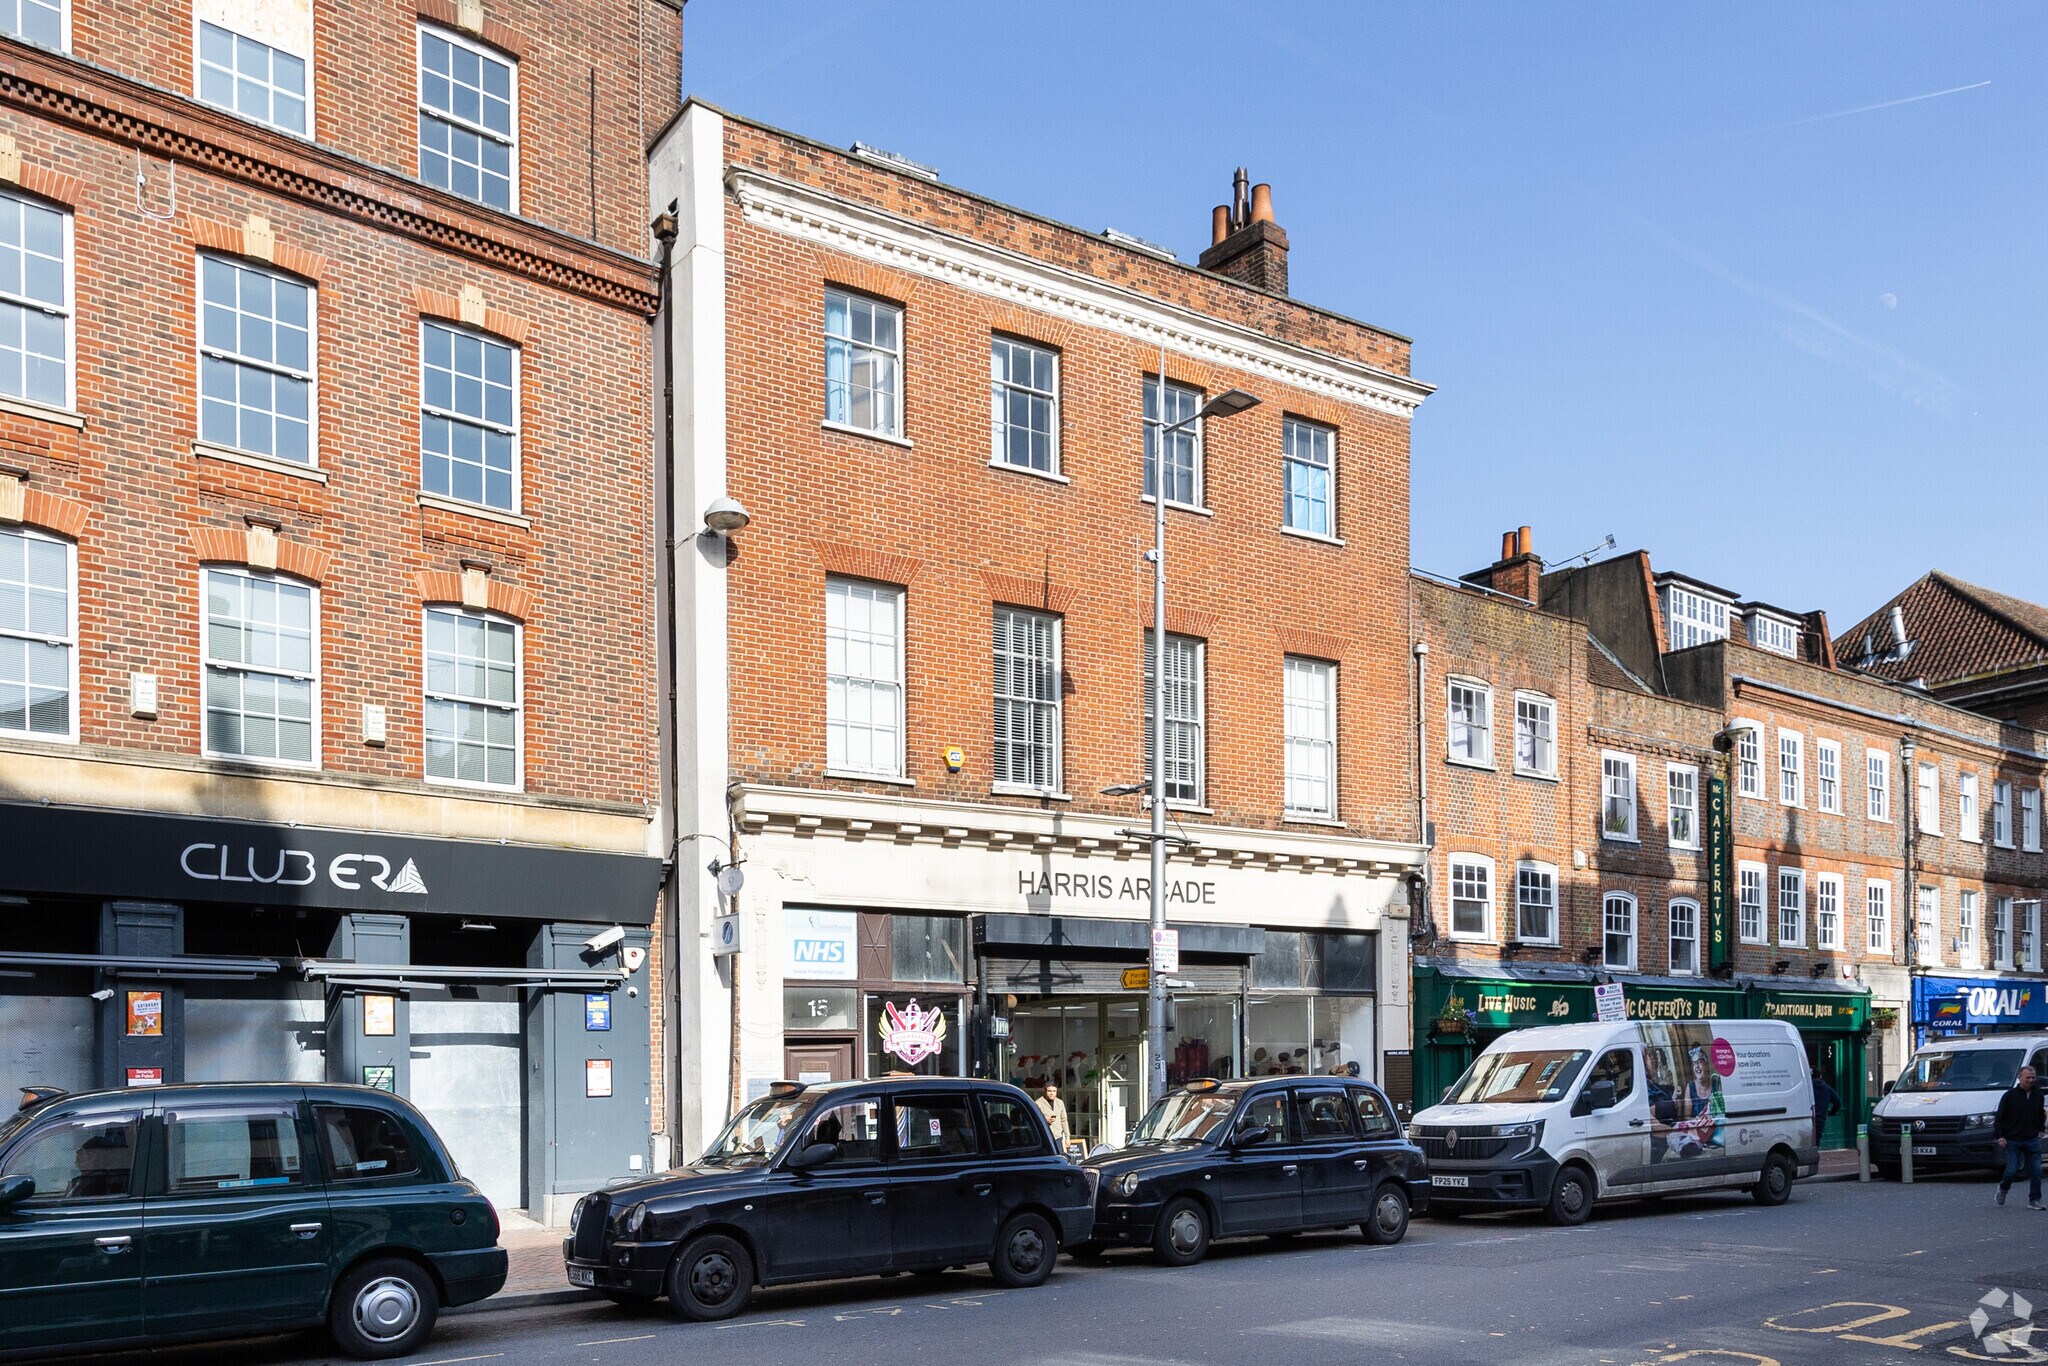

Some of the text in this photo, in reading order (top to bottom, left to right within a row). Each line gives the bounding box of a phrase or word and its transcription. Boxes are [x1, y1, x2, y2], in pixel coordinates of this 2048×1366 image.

[180, 843, 316, 886] CLUB
[1018, 870, 1216, 905] HARRIS ARADE
[795, 940, 844, 961] NHS
[1478, 994, 1503, 1012] LIVE
[1504, 995, 1536, 1013] MUSIC
[1698, 1000, 1717, 1017] BAR
[1815, 1004, 1833, 1018] IRISH
[1434, 1177, 1451, 1185] FP25
